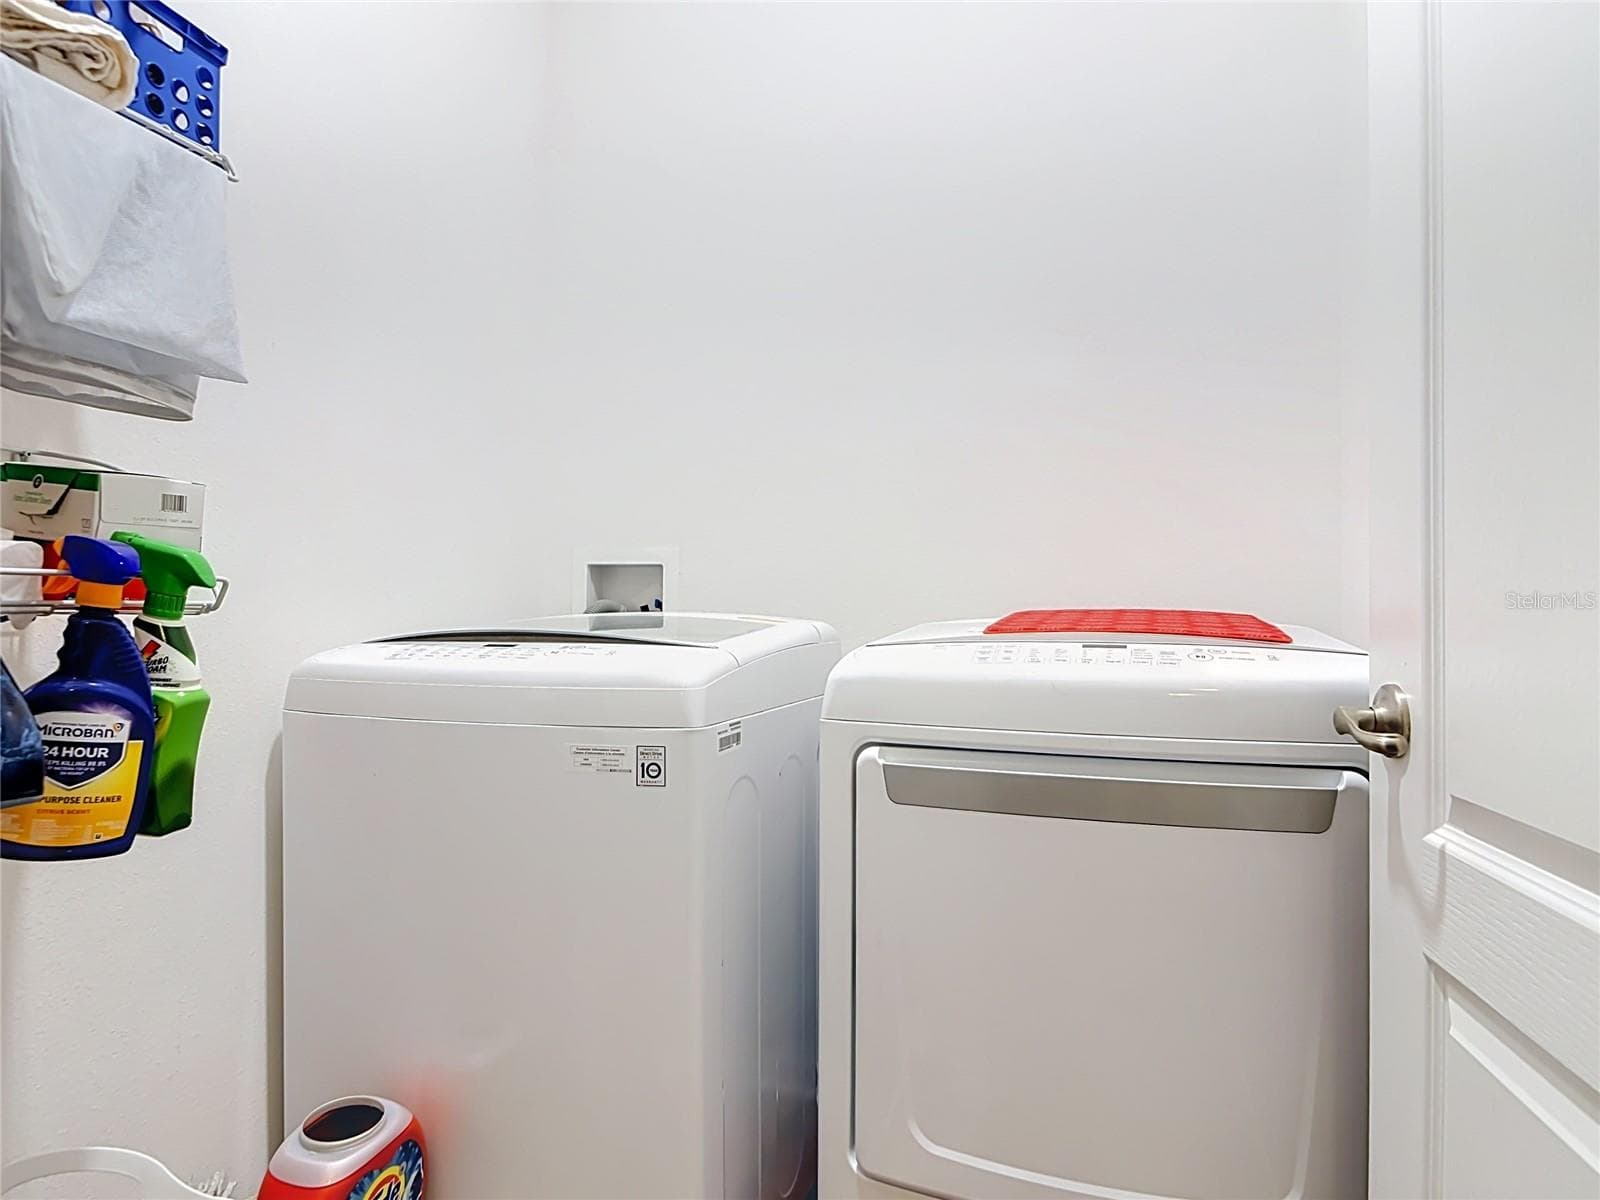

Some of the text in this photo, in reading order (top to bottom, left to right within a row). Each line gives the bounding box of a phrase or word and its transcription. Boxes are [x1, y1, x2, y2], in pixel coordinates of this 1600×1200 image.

[144, 656, 169, 667] URBO
[146, 664, 168, 673] OAM
[38, 725, 114, 738] MICROBAN
[42, 745, 109, 758] 24 HOUR
[641, 762, 662, 779] 10
[83, 795, 122, 803] CLEANER
